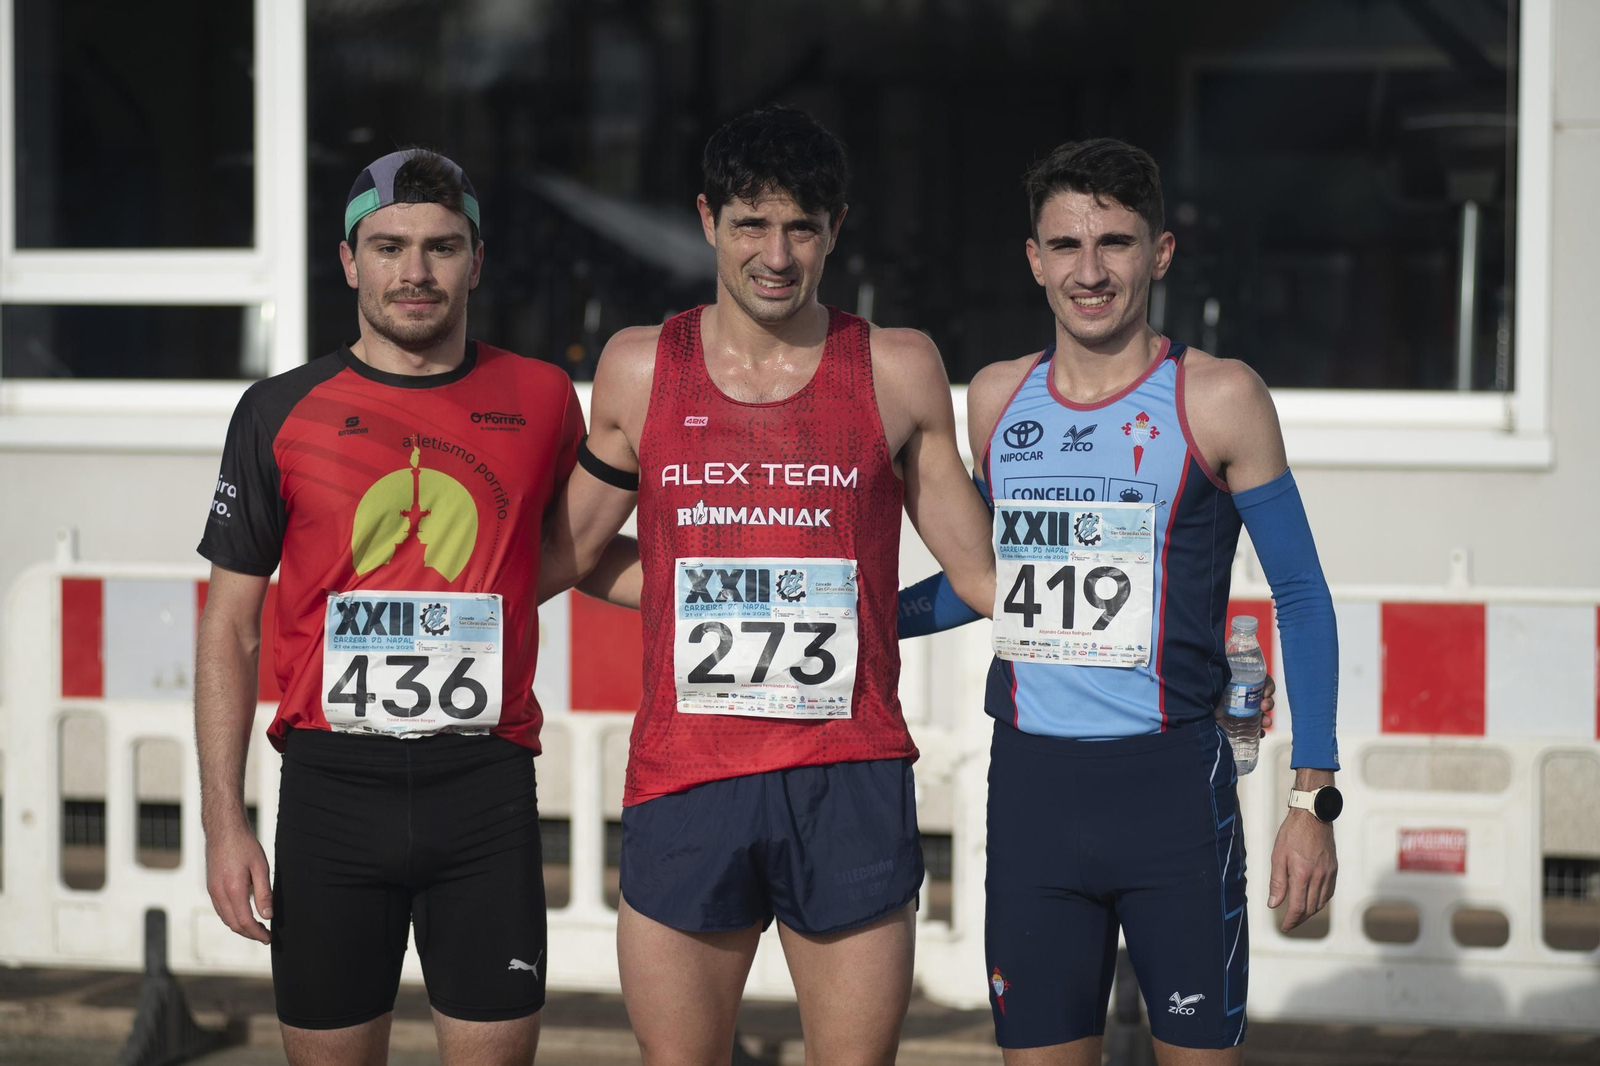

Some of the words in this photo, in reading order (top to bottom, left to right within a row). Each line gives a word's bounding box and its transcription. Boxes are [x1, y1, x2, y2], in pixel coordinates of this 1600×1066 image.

[1000, 450, 1044, 464] NIPOCAR
[1060, 440, 1094, 452] ZICO
[661, 462, 750, 487] ALEX
[760, 463, 858, 489] TEAM
[473, 462, 509, 520] porriño
[1011, 487, 1096, 502] CONCELLO
[677, 500, 832, 527] RUNMANIAK
[1000, 511, 1070, 546] XXII
[684, 569, 770, 604] XXII
[1004, 564, 1132, 631] 419
[334, 601, 415, 637] XXII
[684, 604, 723, 612] CARREIRA
[333, 636, 367, 644] CARREIRA
[687, 621, 837, 685] 273
[327, 654, 488, 720] 436
[1167, 1005, 1196, 1016] ZICO
